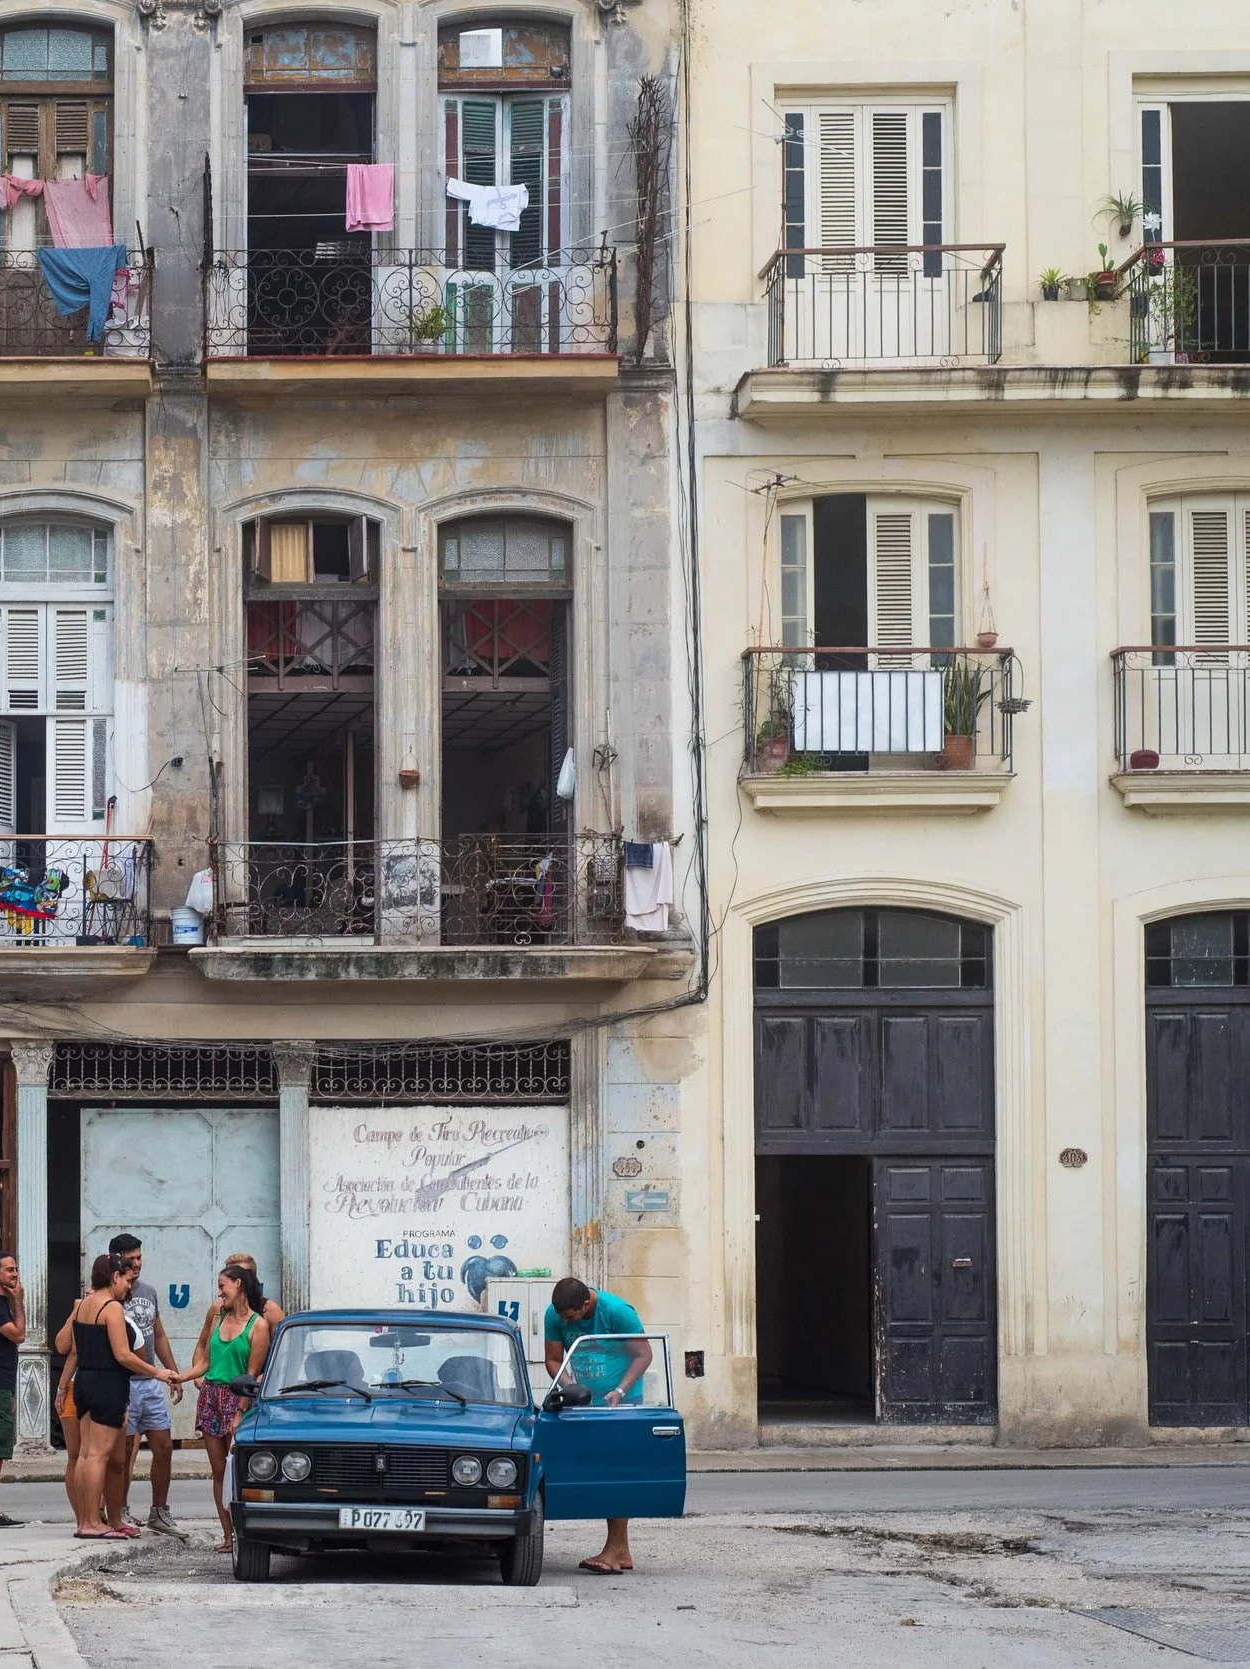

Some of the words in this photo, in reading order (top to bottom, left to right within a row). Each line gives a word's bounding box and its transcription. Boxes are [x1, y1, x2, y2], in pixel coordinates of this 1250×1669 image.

[353, 1123, 403, 1150] Campo
[410, 1125, 423, 1142] de
[428, 1116, 459, 1141] Tiro
[402, 1145, 466, 1174] Popular
[401, 1175, 415, 1191] de
[507, 1173, 523, 1190] de
[460, 1192, 524, 1212] Cubana
[402, 1229, 456, 1238] PROGRAMA
[375, 1239, 454, 1258] Educa
[401, 1265, 413, 1280] a
[423, 1260, 454, 1280] tu
[395, 1282, 454, 1310] hijo
